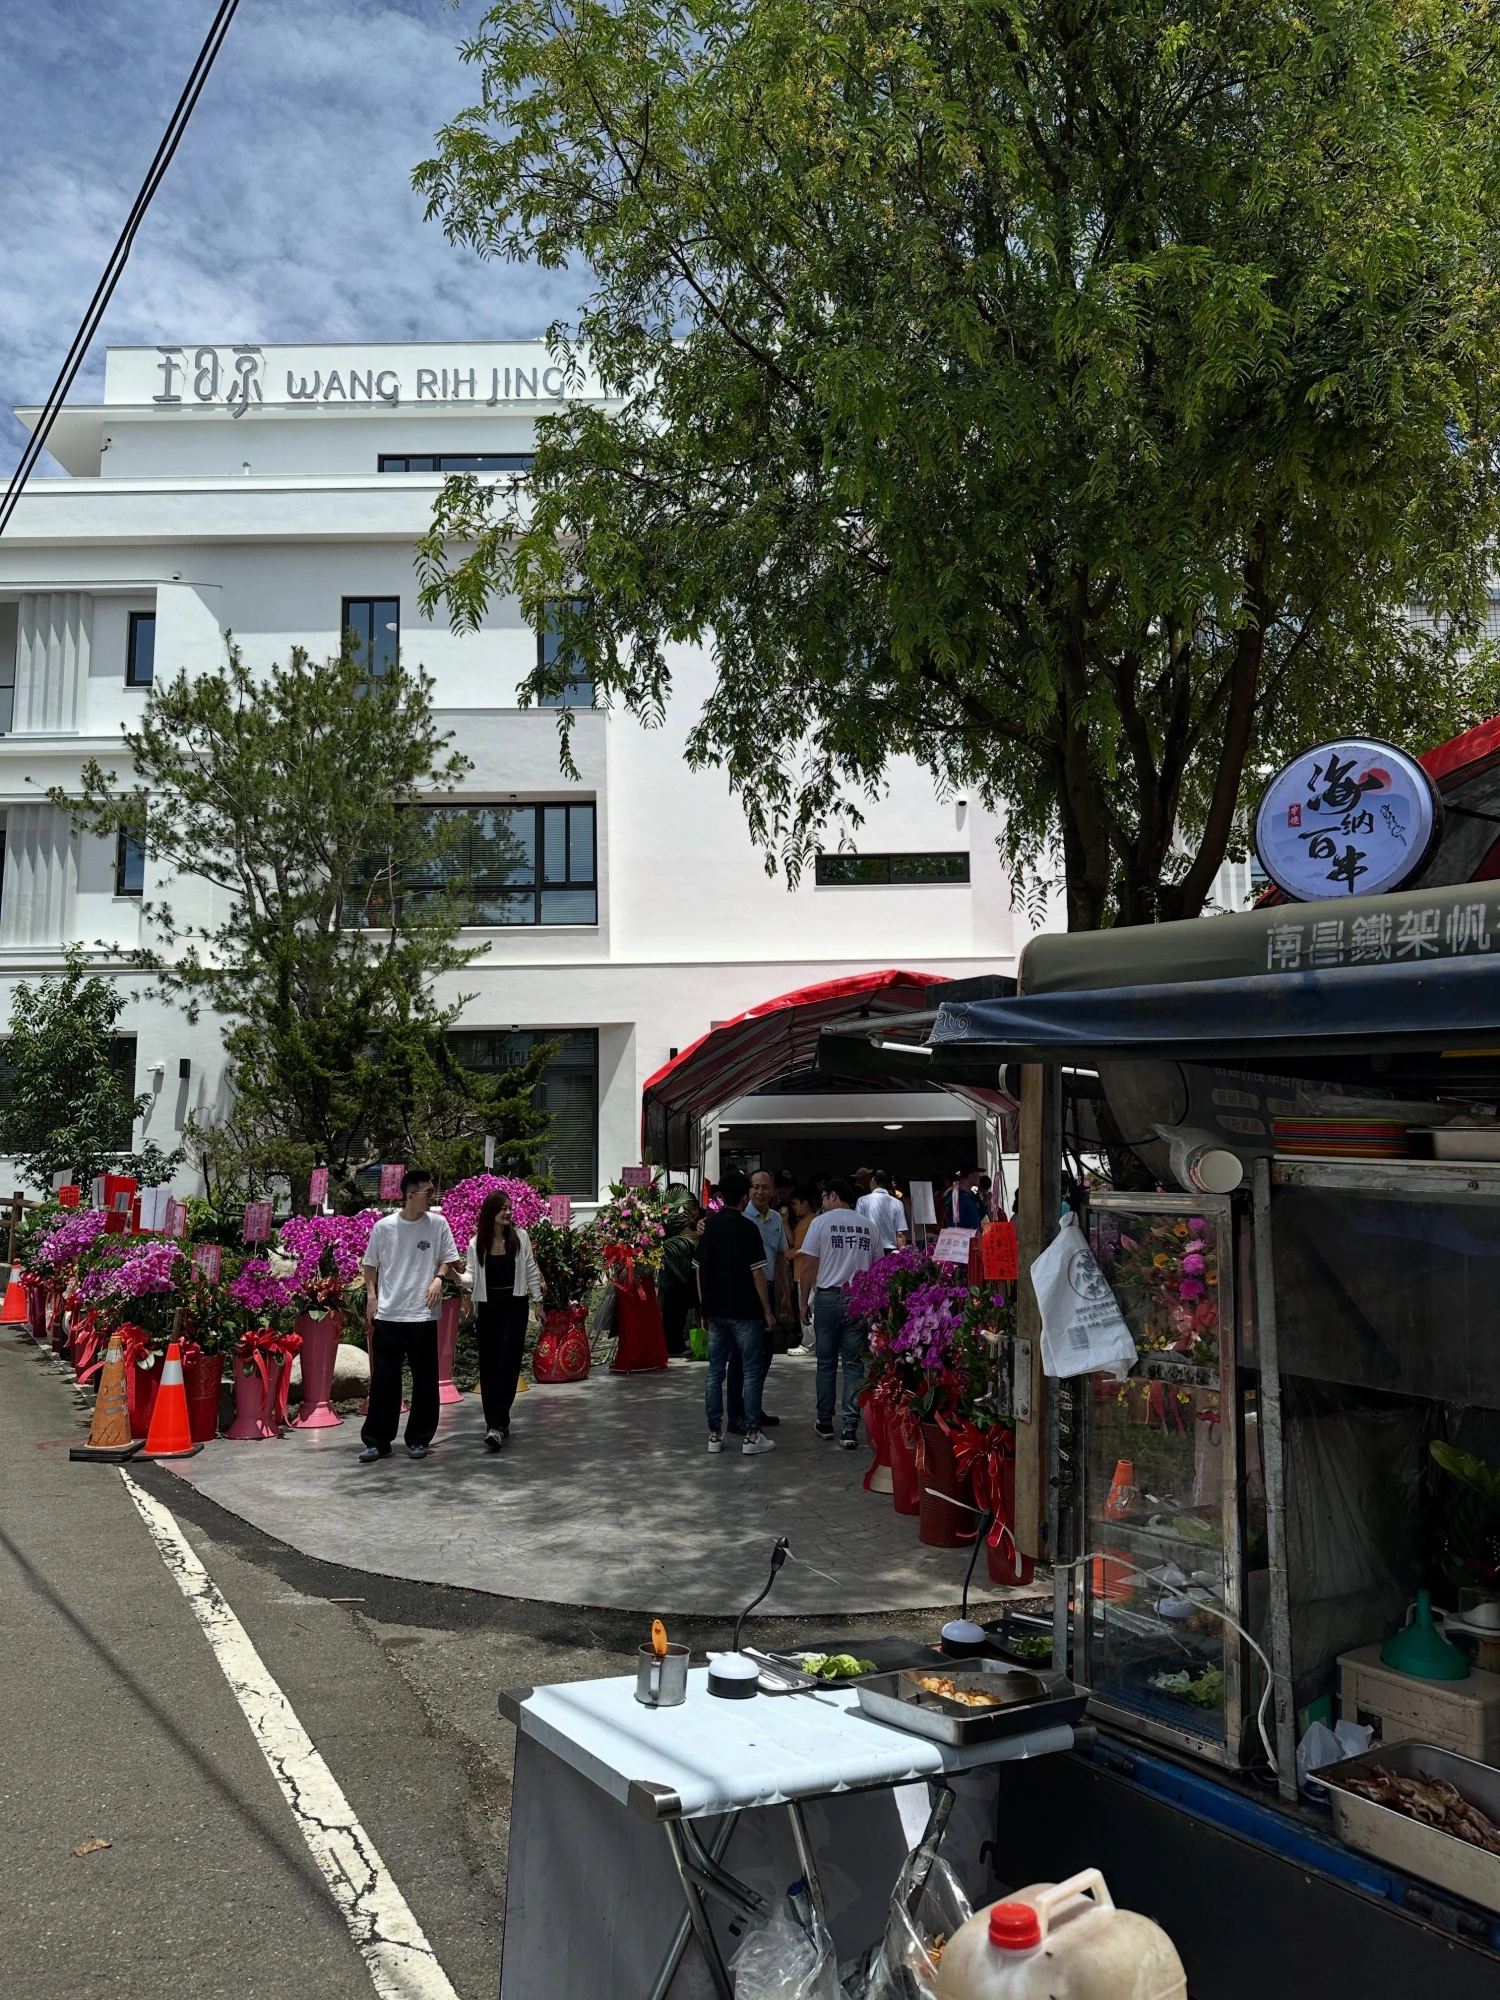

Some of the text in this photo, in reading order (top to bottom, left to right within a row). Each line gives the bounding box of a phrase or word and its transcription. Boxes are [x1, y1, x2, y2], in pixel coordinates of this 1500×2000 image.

[287, 367, 565, 407] WANG RIH JING
[1266, 903, 1500, 970] 南昌鐵架帆
[830, 1225, 870, 1236] 南投縣議員
[831, 1235, 871, 1252] 簡千翔
